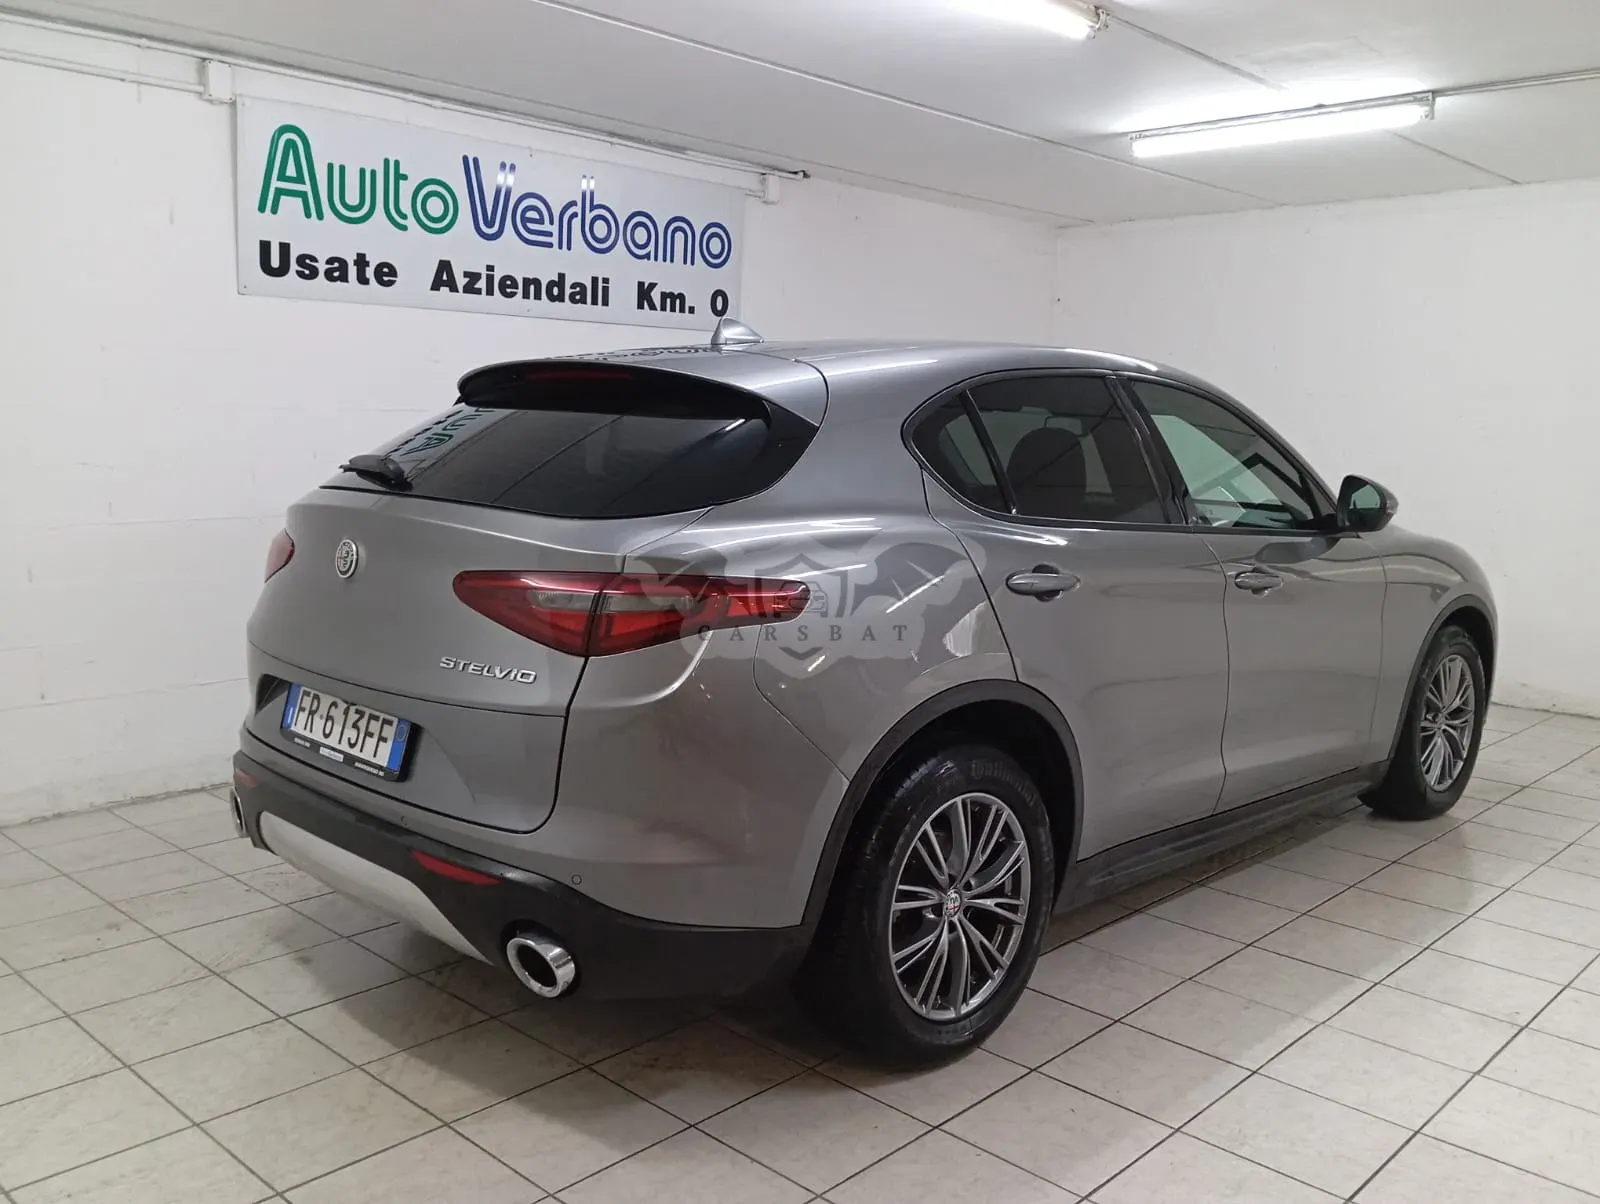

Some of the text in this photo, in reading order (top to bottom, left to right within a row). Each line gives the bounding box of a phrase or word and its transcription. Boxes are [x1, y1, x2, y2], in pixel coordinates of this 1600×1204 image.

[259, 239, 729, 318] Usate Aziendali Km. 0
[439, 656, 537, 684] STELVIO
